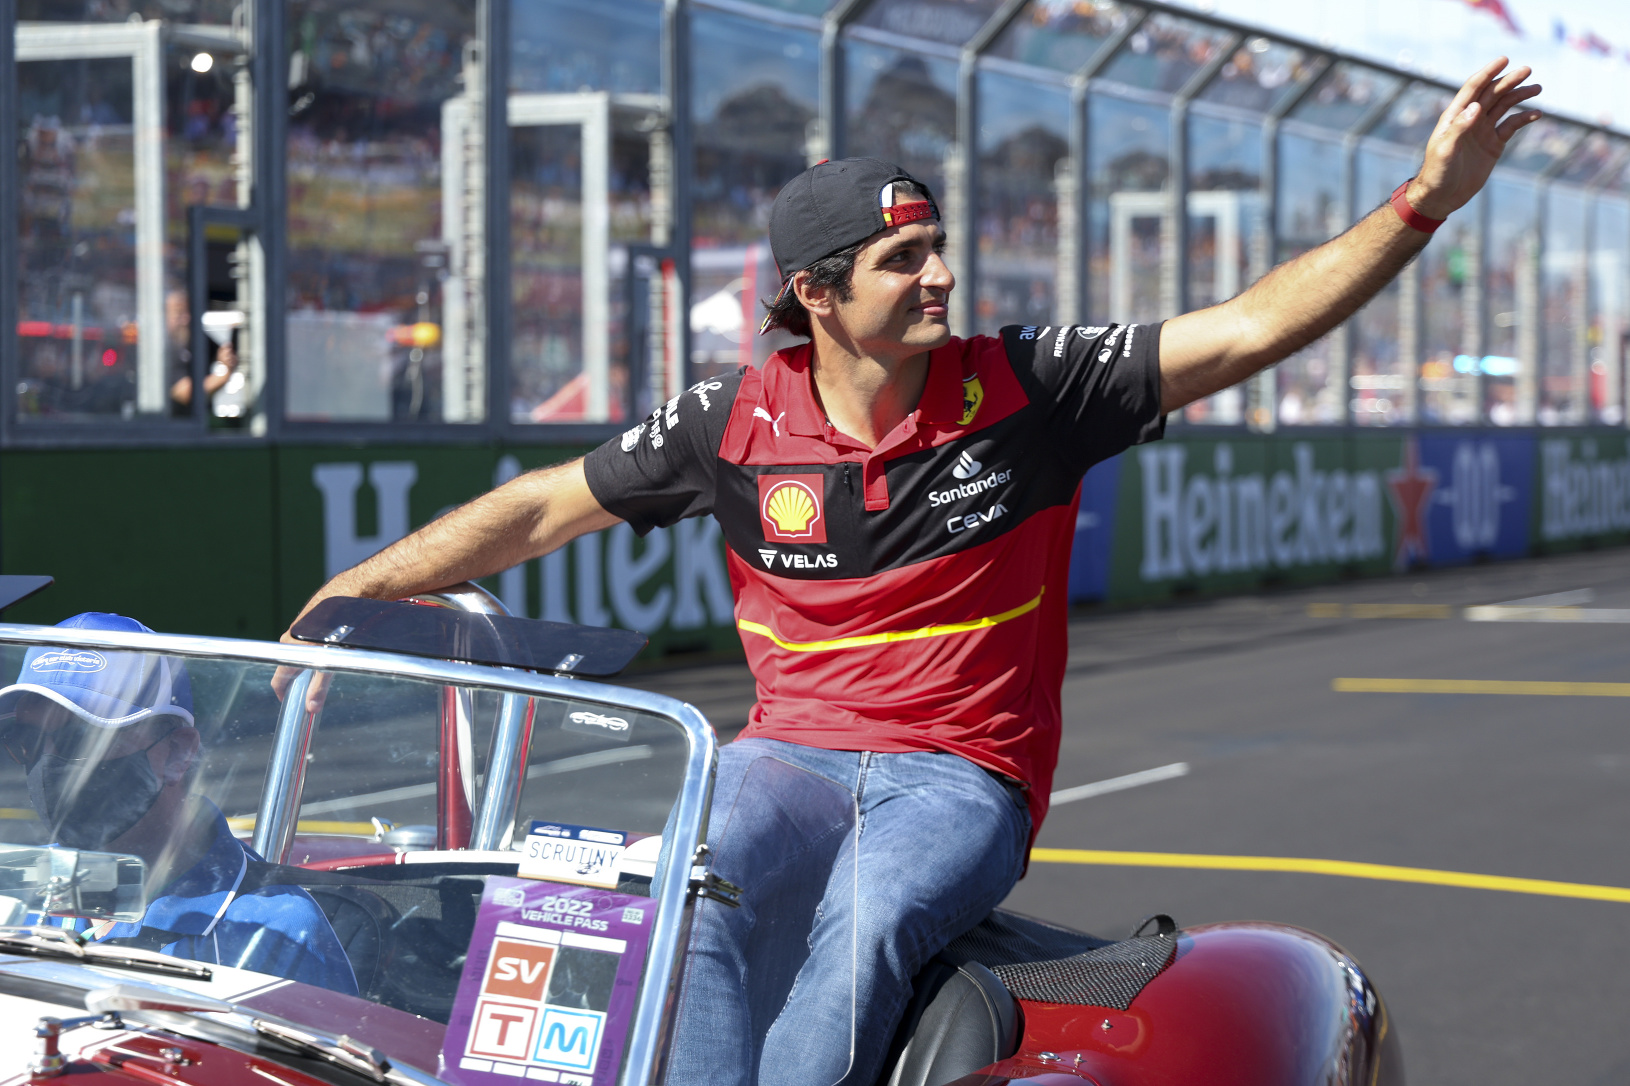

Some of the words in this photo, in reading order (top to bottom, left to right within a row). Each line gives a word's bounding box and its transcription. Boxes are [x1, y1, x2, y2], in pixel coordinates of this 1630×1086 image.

[928, 468, 1012, 508] Santander
[1540, 438, 1630, 540] Heine
[1139, 443, 1385, 580] Heineken
[780, 553, 839, 569] VELAS
[529, 841, 619, 868] SCRUTINY
[520, 907, 573, 927] VEHICLE
[573, 916, 609, 932] PASS
[541, 895, 593, 917] 2022
[494, 956, 546, 985] SV
[490, 1012, 524, 1046] T
[543, 1021, 588, 1056] M
